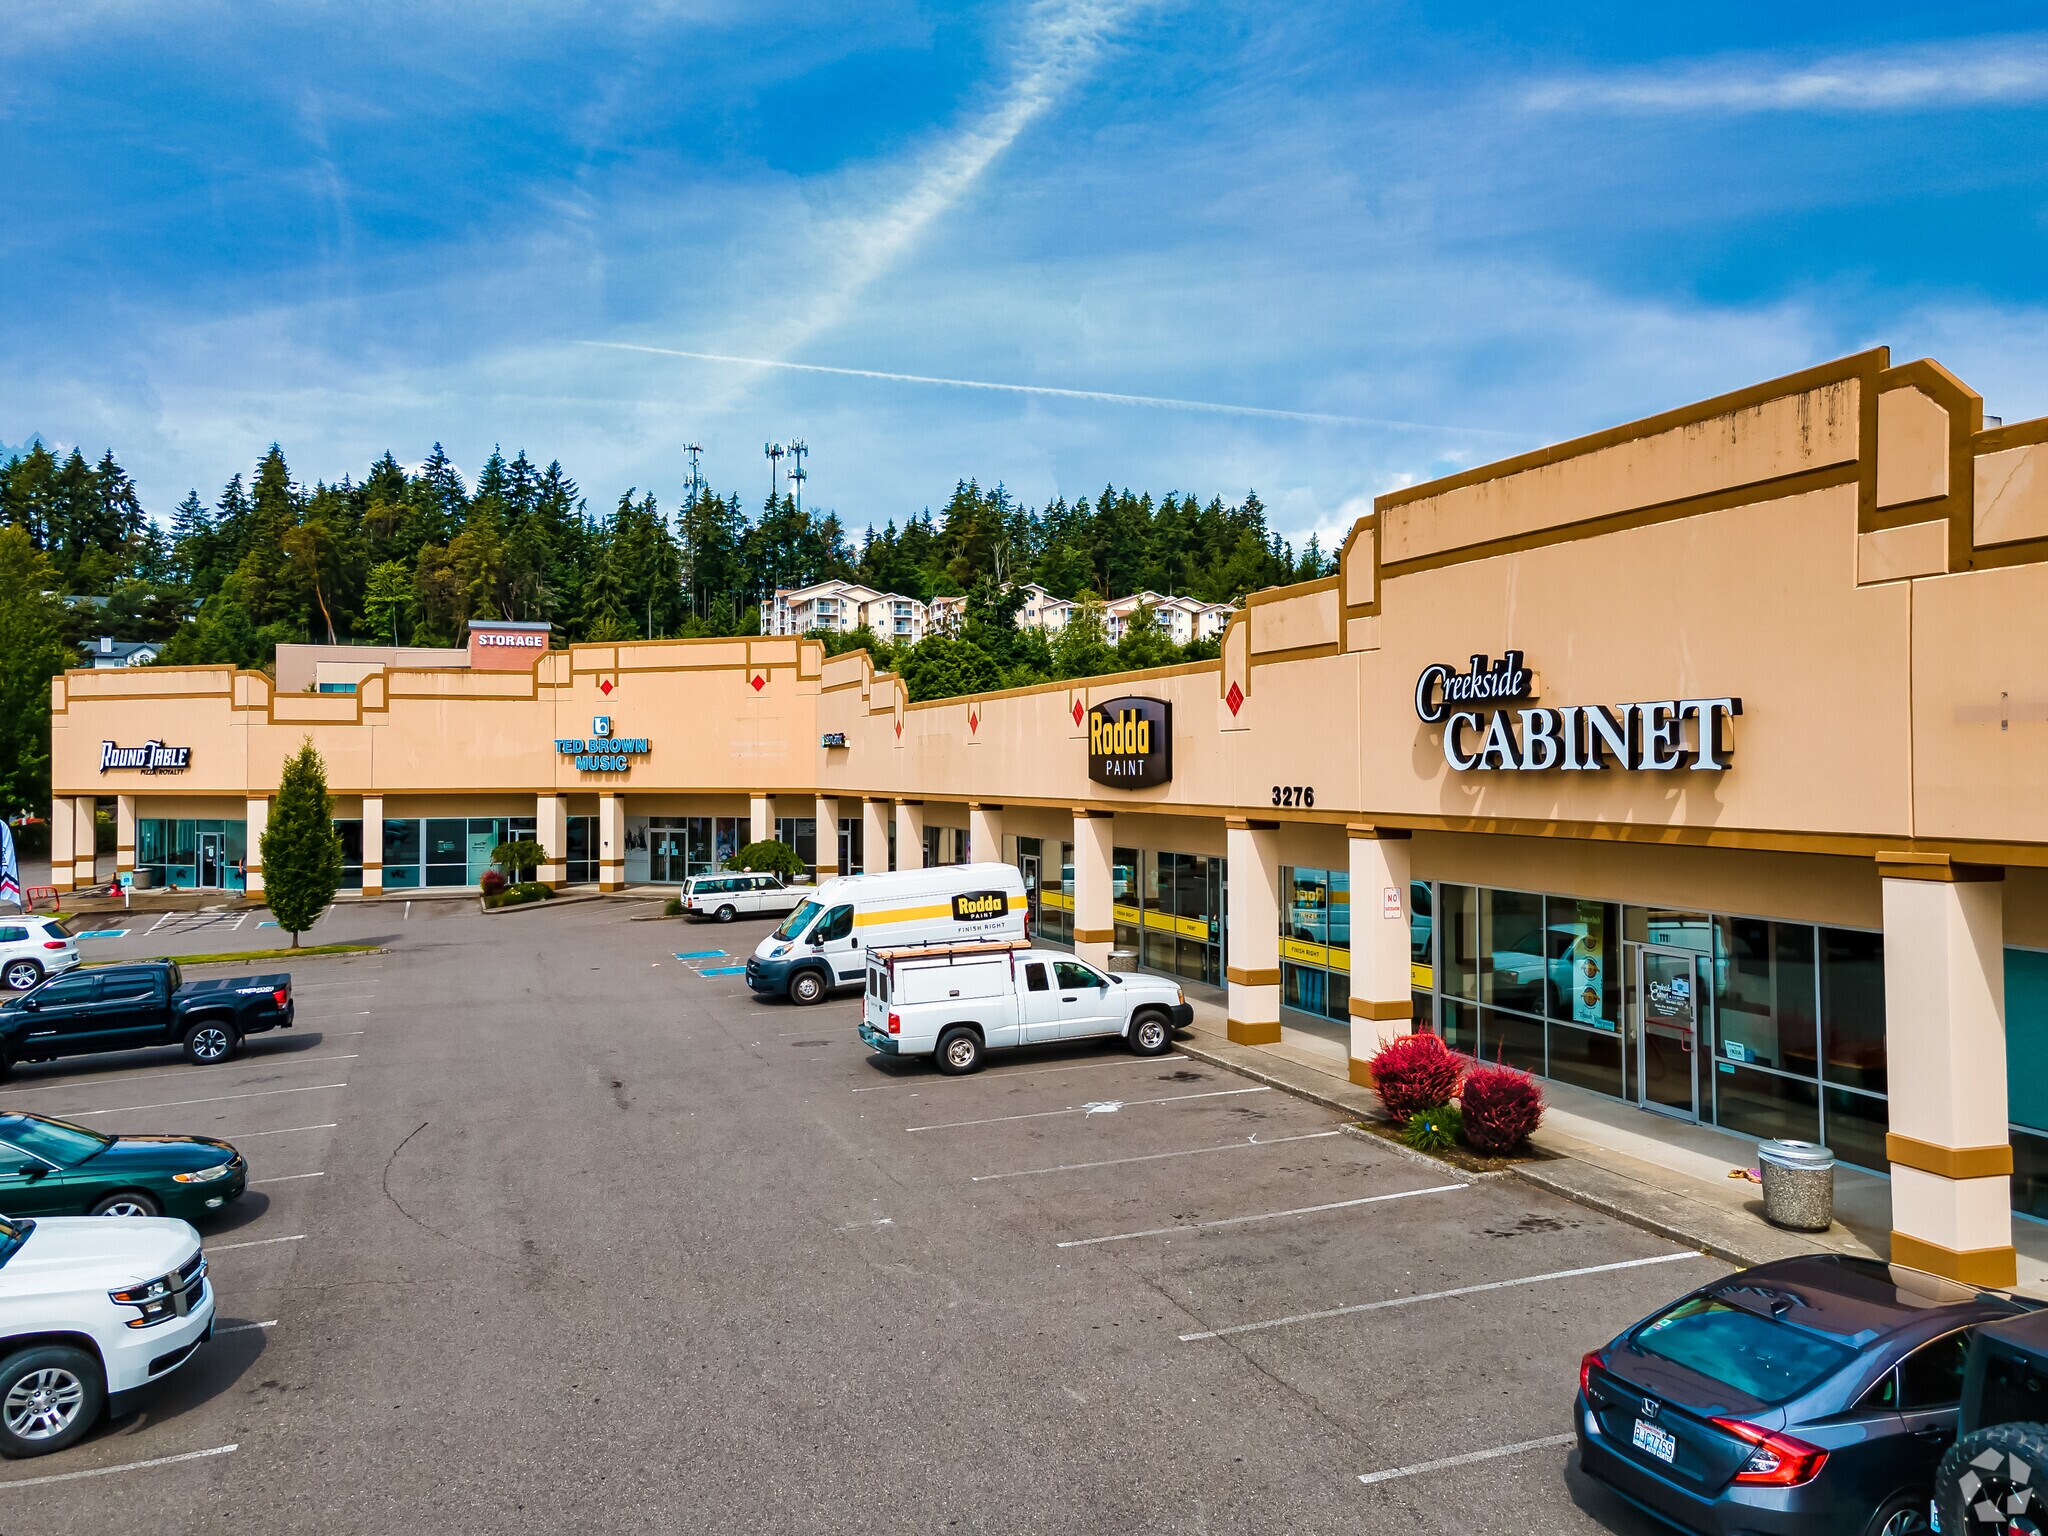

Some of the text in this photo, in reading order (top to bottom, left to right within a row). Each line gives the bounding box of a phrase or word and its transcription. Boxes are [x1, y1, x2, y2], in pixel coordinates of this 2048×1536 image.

[478, 634, 543, 647] STORAGE
[1415, 651, 1524, 722] Creekside
[1091, 708, 1150, 756] Rodda
[1443, 697, 1735, 772] CABINET
[553, 738, 648, 754] TED BROWN
[575, 755, 628, 771] MUSIC
[1106, 760, 1145, 776] PAINT
[1272, 786, 1315, 808] 3276
[958, 895, 1002, 915] Rodda
[1387, 894, 1398, 903] NO
[958, 922, 1005, 933] FINISH RIGHT
[1305, 949, 1320, 958] RIGHT
[1635, 1426, 1673, 1456] BJC7769
